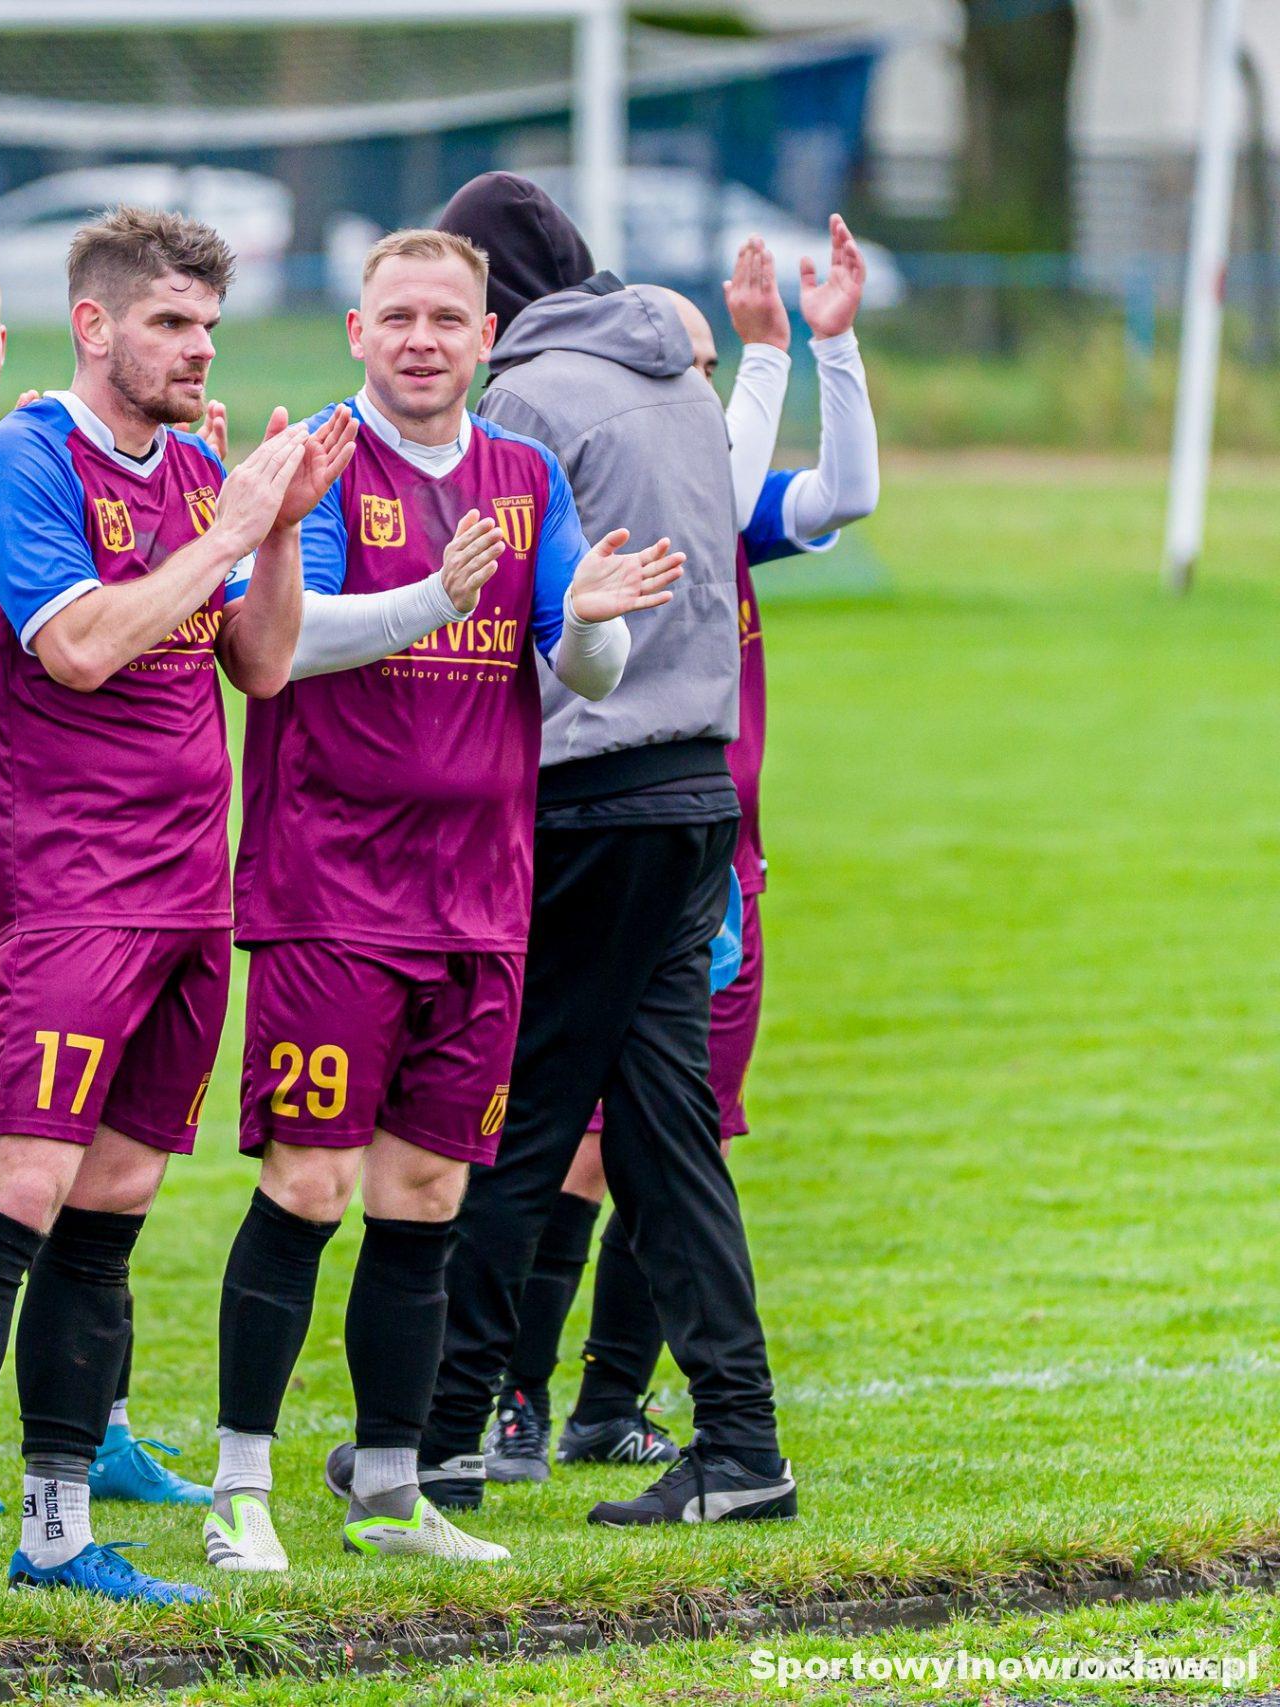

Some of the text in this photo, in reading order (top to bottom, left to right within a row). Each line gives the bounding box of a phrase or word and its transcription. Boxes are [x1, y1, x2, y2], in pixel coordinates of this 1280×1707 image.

[381, 667, 440, 681] Okulary
[447, 670, 469, 681] dla
[35, 1031, 105, 1115] 17
[270, 1041, 349, 1119] 29
